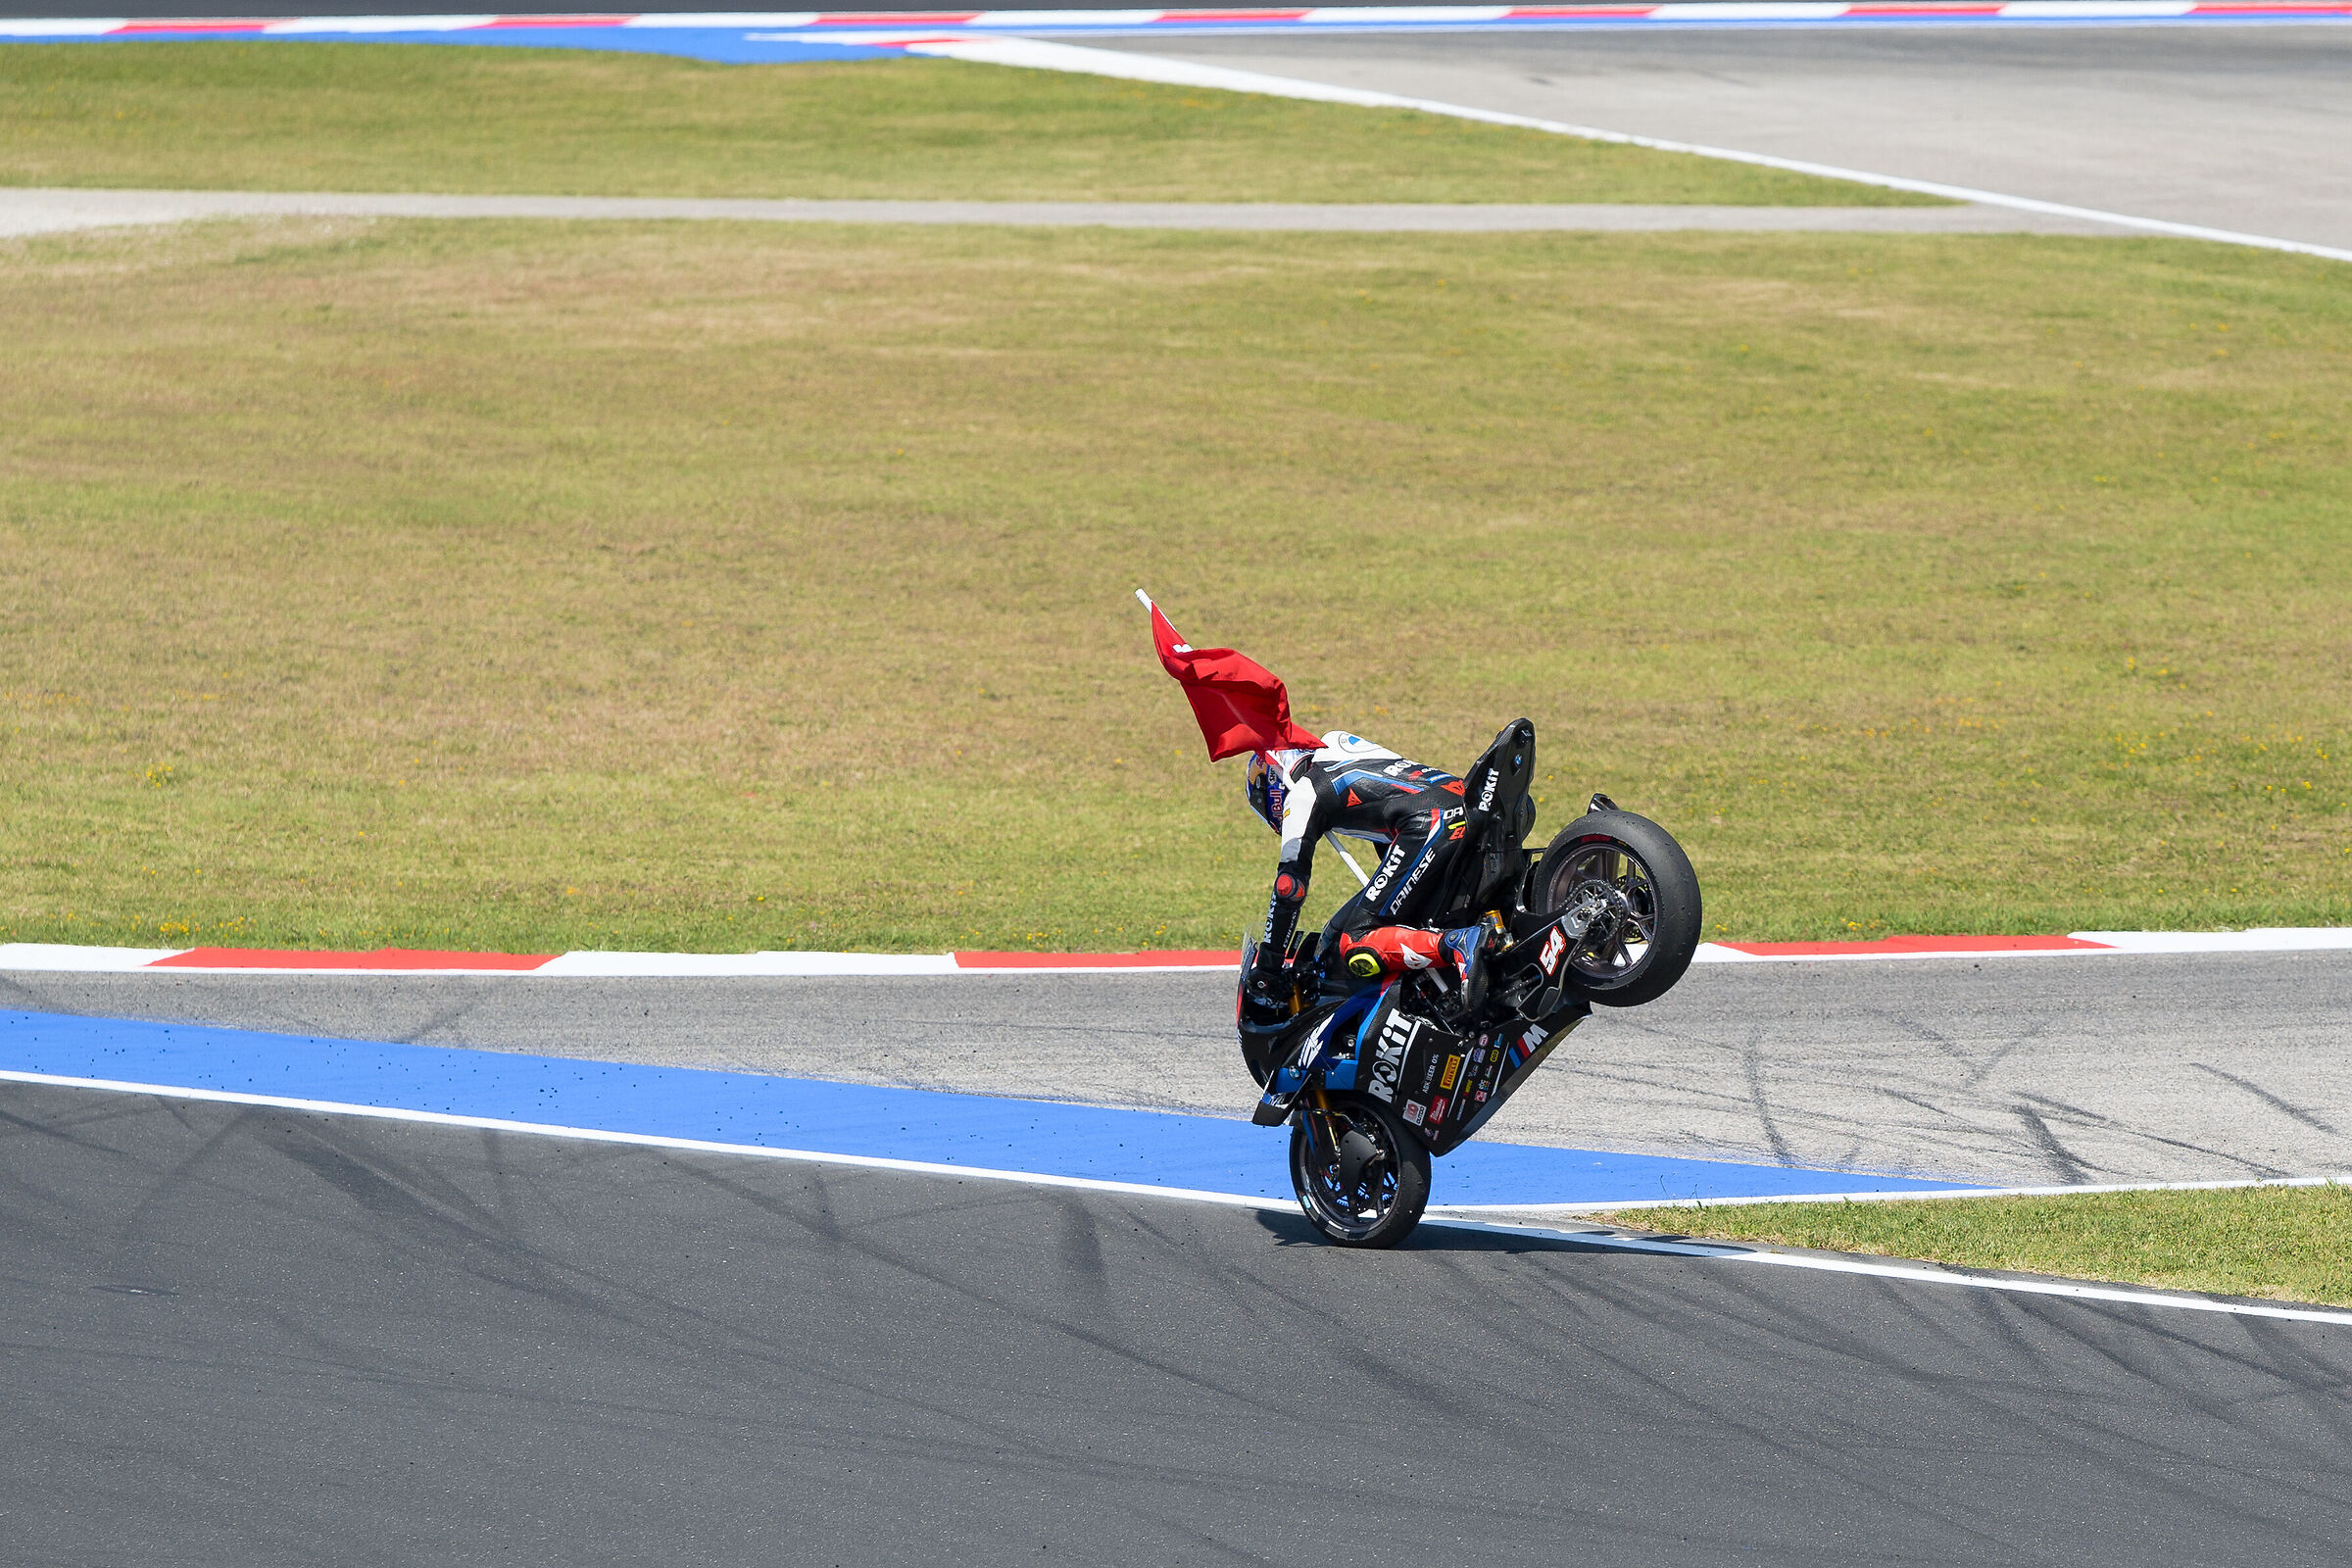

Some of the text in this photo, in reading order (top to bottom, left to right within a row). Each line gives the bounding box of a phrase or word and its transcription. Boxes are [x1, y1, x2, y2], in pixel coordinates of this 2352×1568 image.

[1271, 789, 1282, 812] Bull
[1390, 848, 1436, 914] DAINESE
[1539, 925, 1566, 976] 54
[1426, 1064, 1437, 1081] BEER
[1443, 1056, 1458, 1087] PIRELLI
